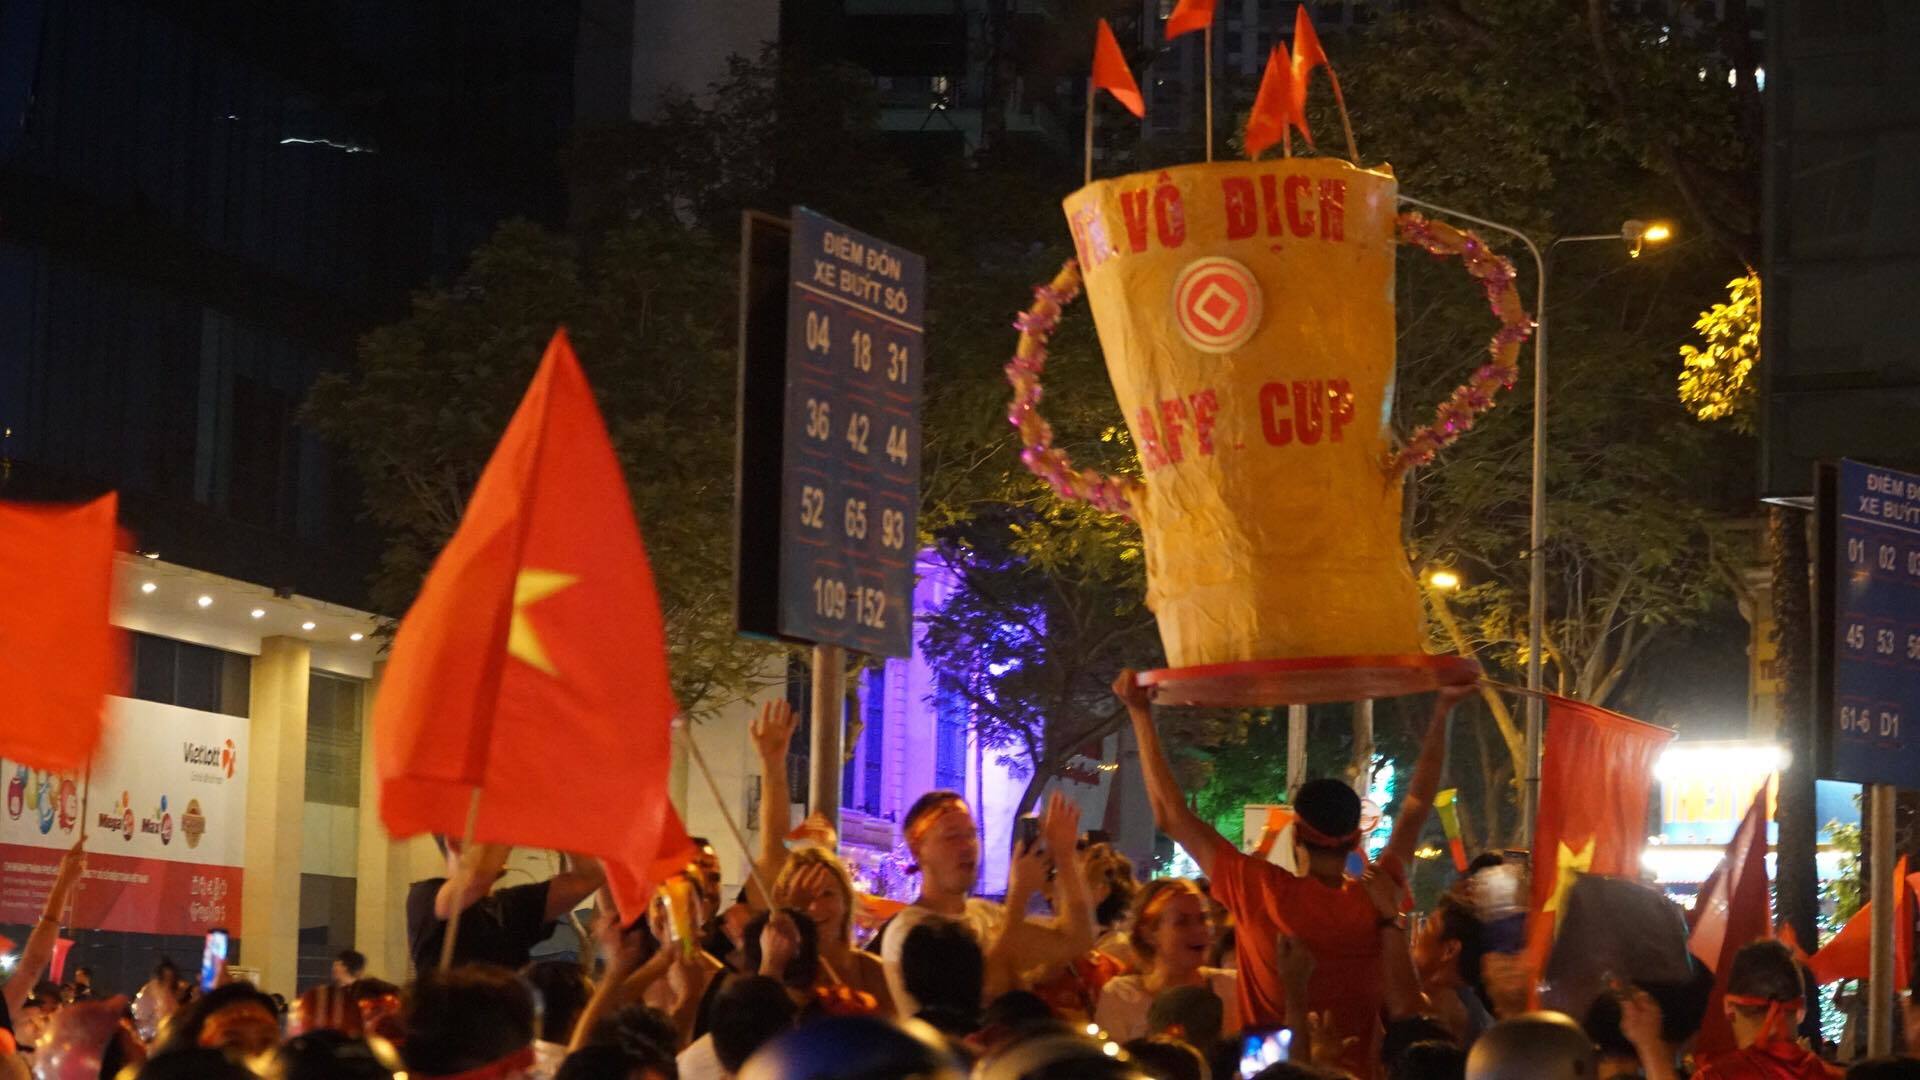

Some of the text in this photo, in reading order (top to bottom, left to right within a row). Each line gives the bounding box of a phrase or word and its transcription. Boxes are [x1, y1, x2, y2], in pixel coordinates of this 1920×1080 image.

[1119, 170, 1186, 254] VÔ
[1221, 174, 1346, 254] ĐỊCH
[814, 259, 836, 287] XE
[806, 310, 908, 384] 04 18 31
[806, 398, 907, 467] 36 42 44
[1258, 378, 1355, 448] CUP
[801, 485, 905, 550] 52 65 93
[1858, 495, 1880, 516] XE
[1848, 537, 1864, 564] 01
[1878, 544, 1896, 571] 02
[813, 575, 887, 629] 109 152
[1846, 623, 1864, 649] 45
[1877, 628, 1895, 655] 53
[1840, 705, 1899, 738] 61-6 D1
